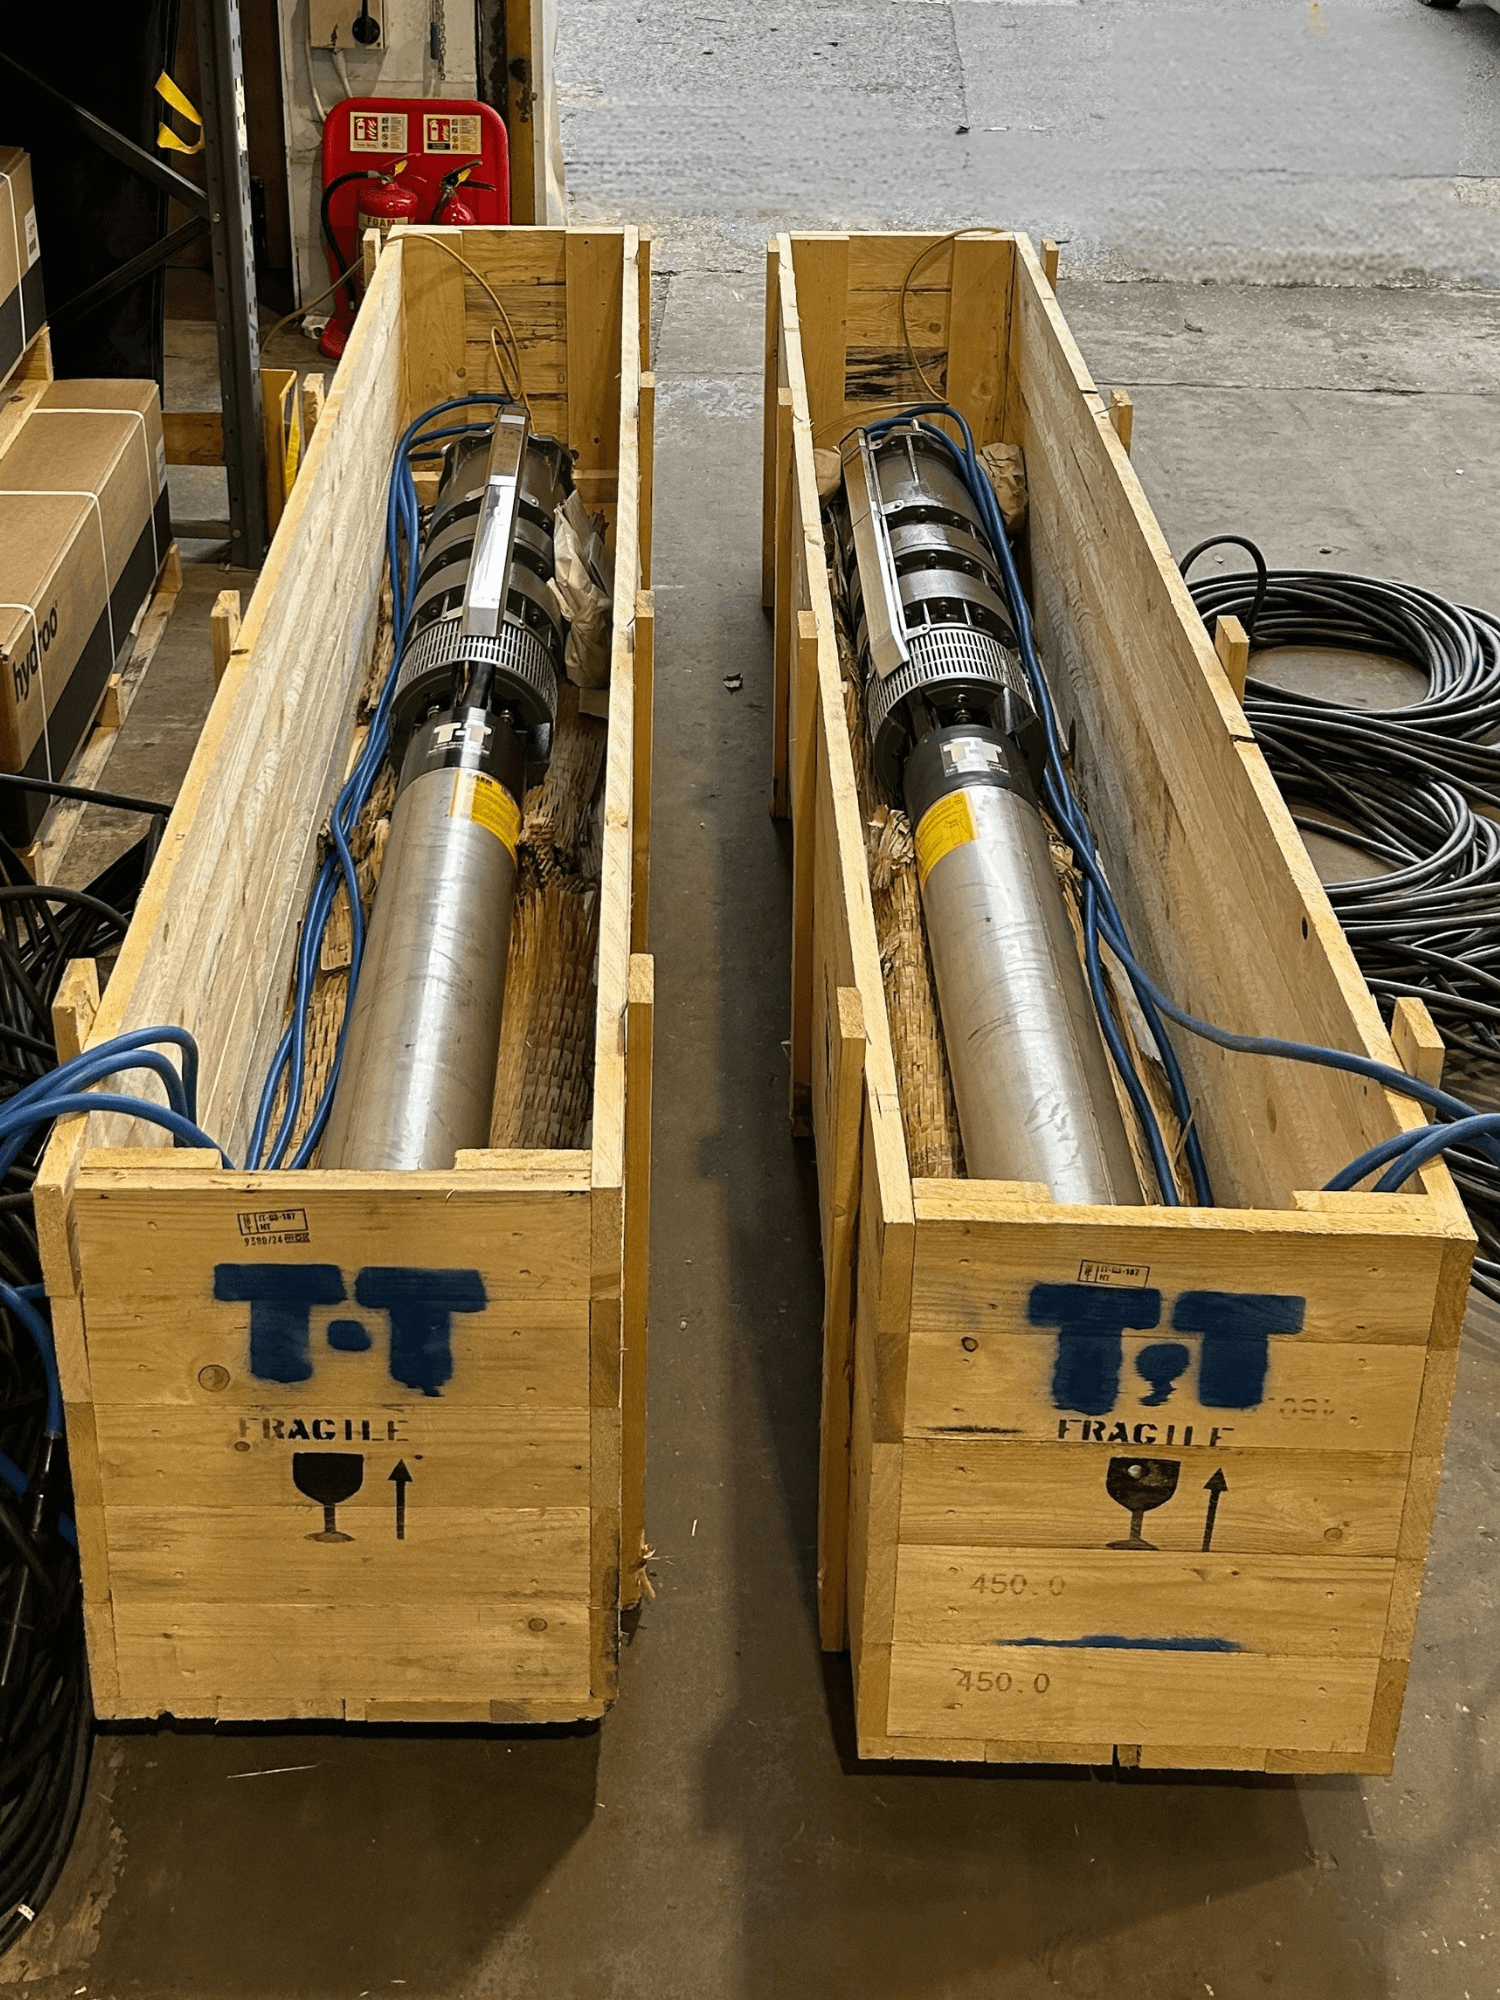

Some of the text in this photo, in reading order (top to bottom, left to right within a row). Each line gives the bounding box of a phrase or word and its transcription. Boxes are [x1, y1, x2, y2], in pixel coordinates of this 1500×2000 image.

[12, 606, 58, 704] hydroo
[239, 1417, 409, 1442] FRAGILE
[967, 1573, 1066, 1596] 450.0
[956, 1670, 1051, 1694] 450.0
